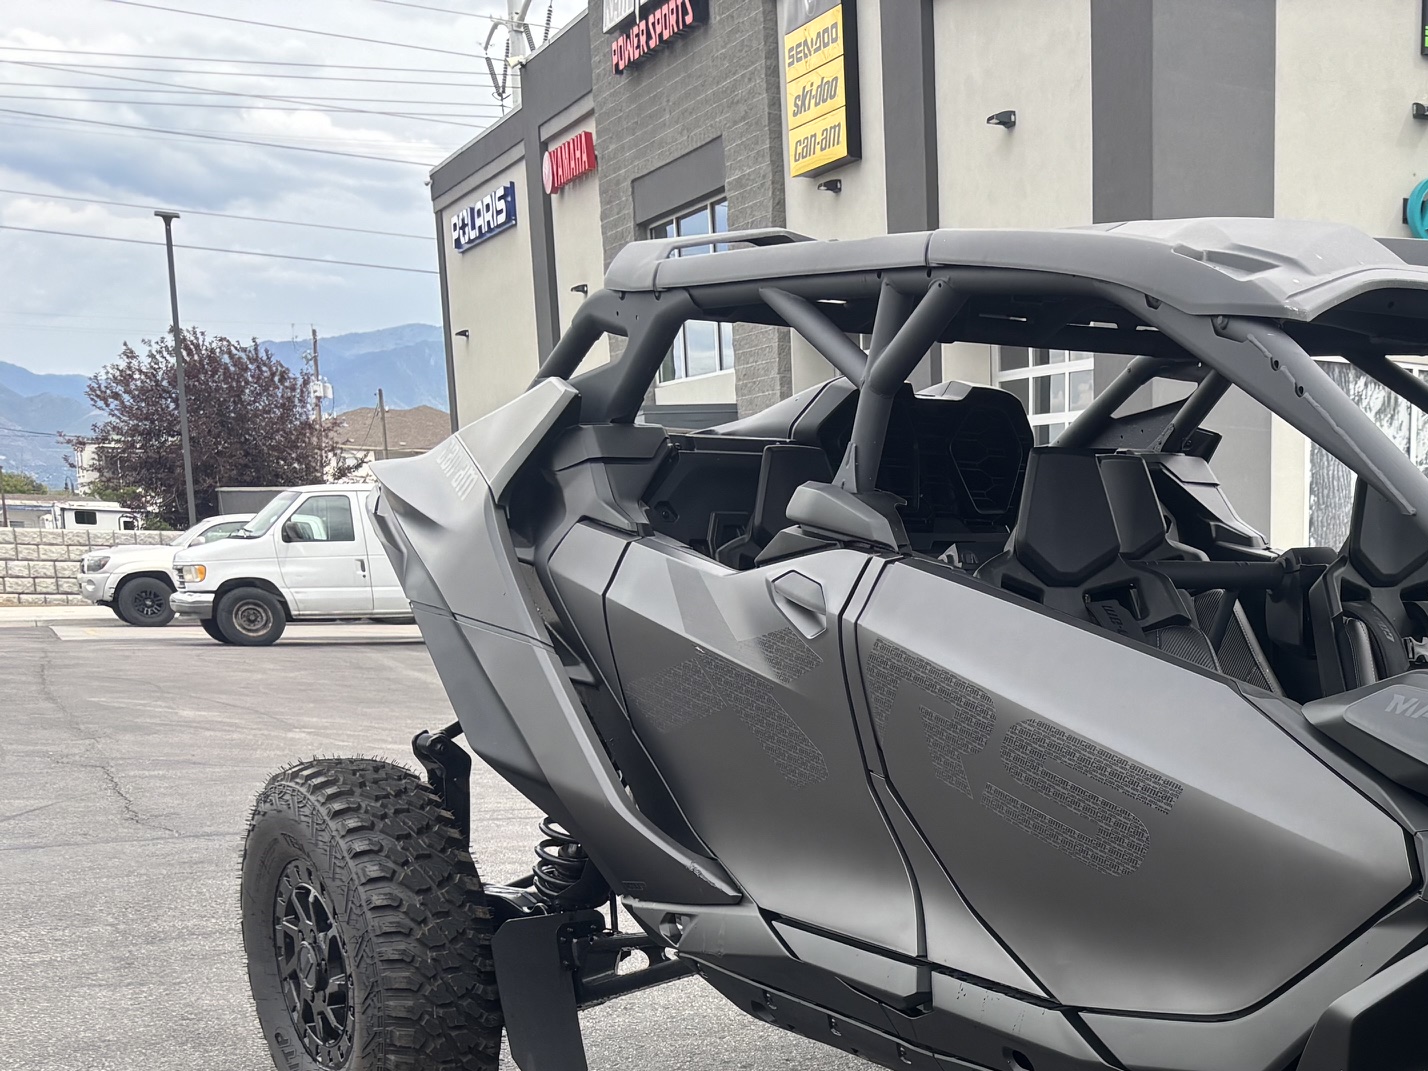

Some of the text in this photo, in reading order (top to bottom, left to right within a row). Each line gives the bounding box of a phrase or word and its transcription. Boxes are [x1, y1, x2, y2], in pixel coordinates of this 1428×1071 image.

[611, 20, 648, 75] POWER
[648, 0, 694, 50] SPORTS
[792, 76, 839, 118] ski-doo
[551, 132, 588, 187] YAMAHA
[794, 121, 841, 163] can-am
[451, 186, 507, 249] POLARIS
